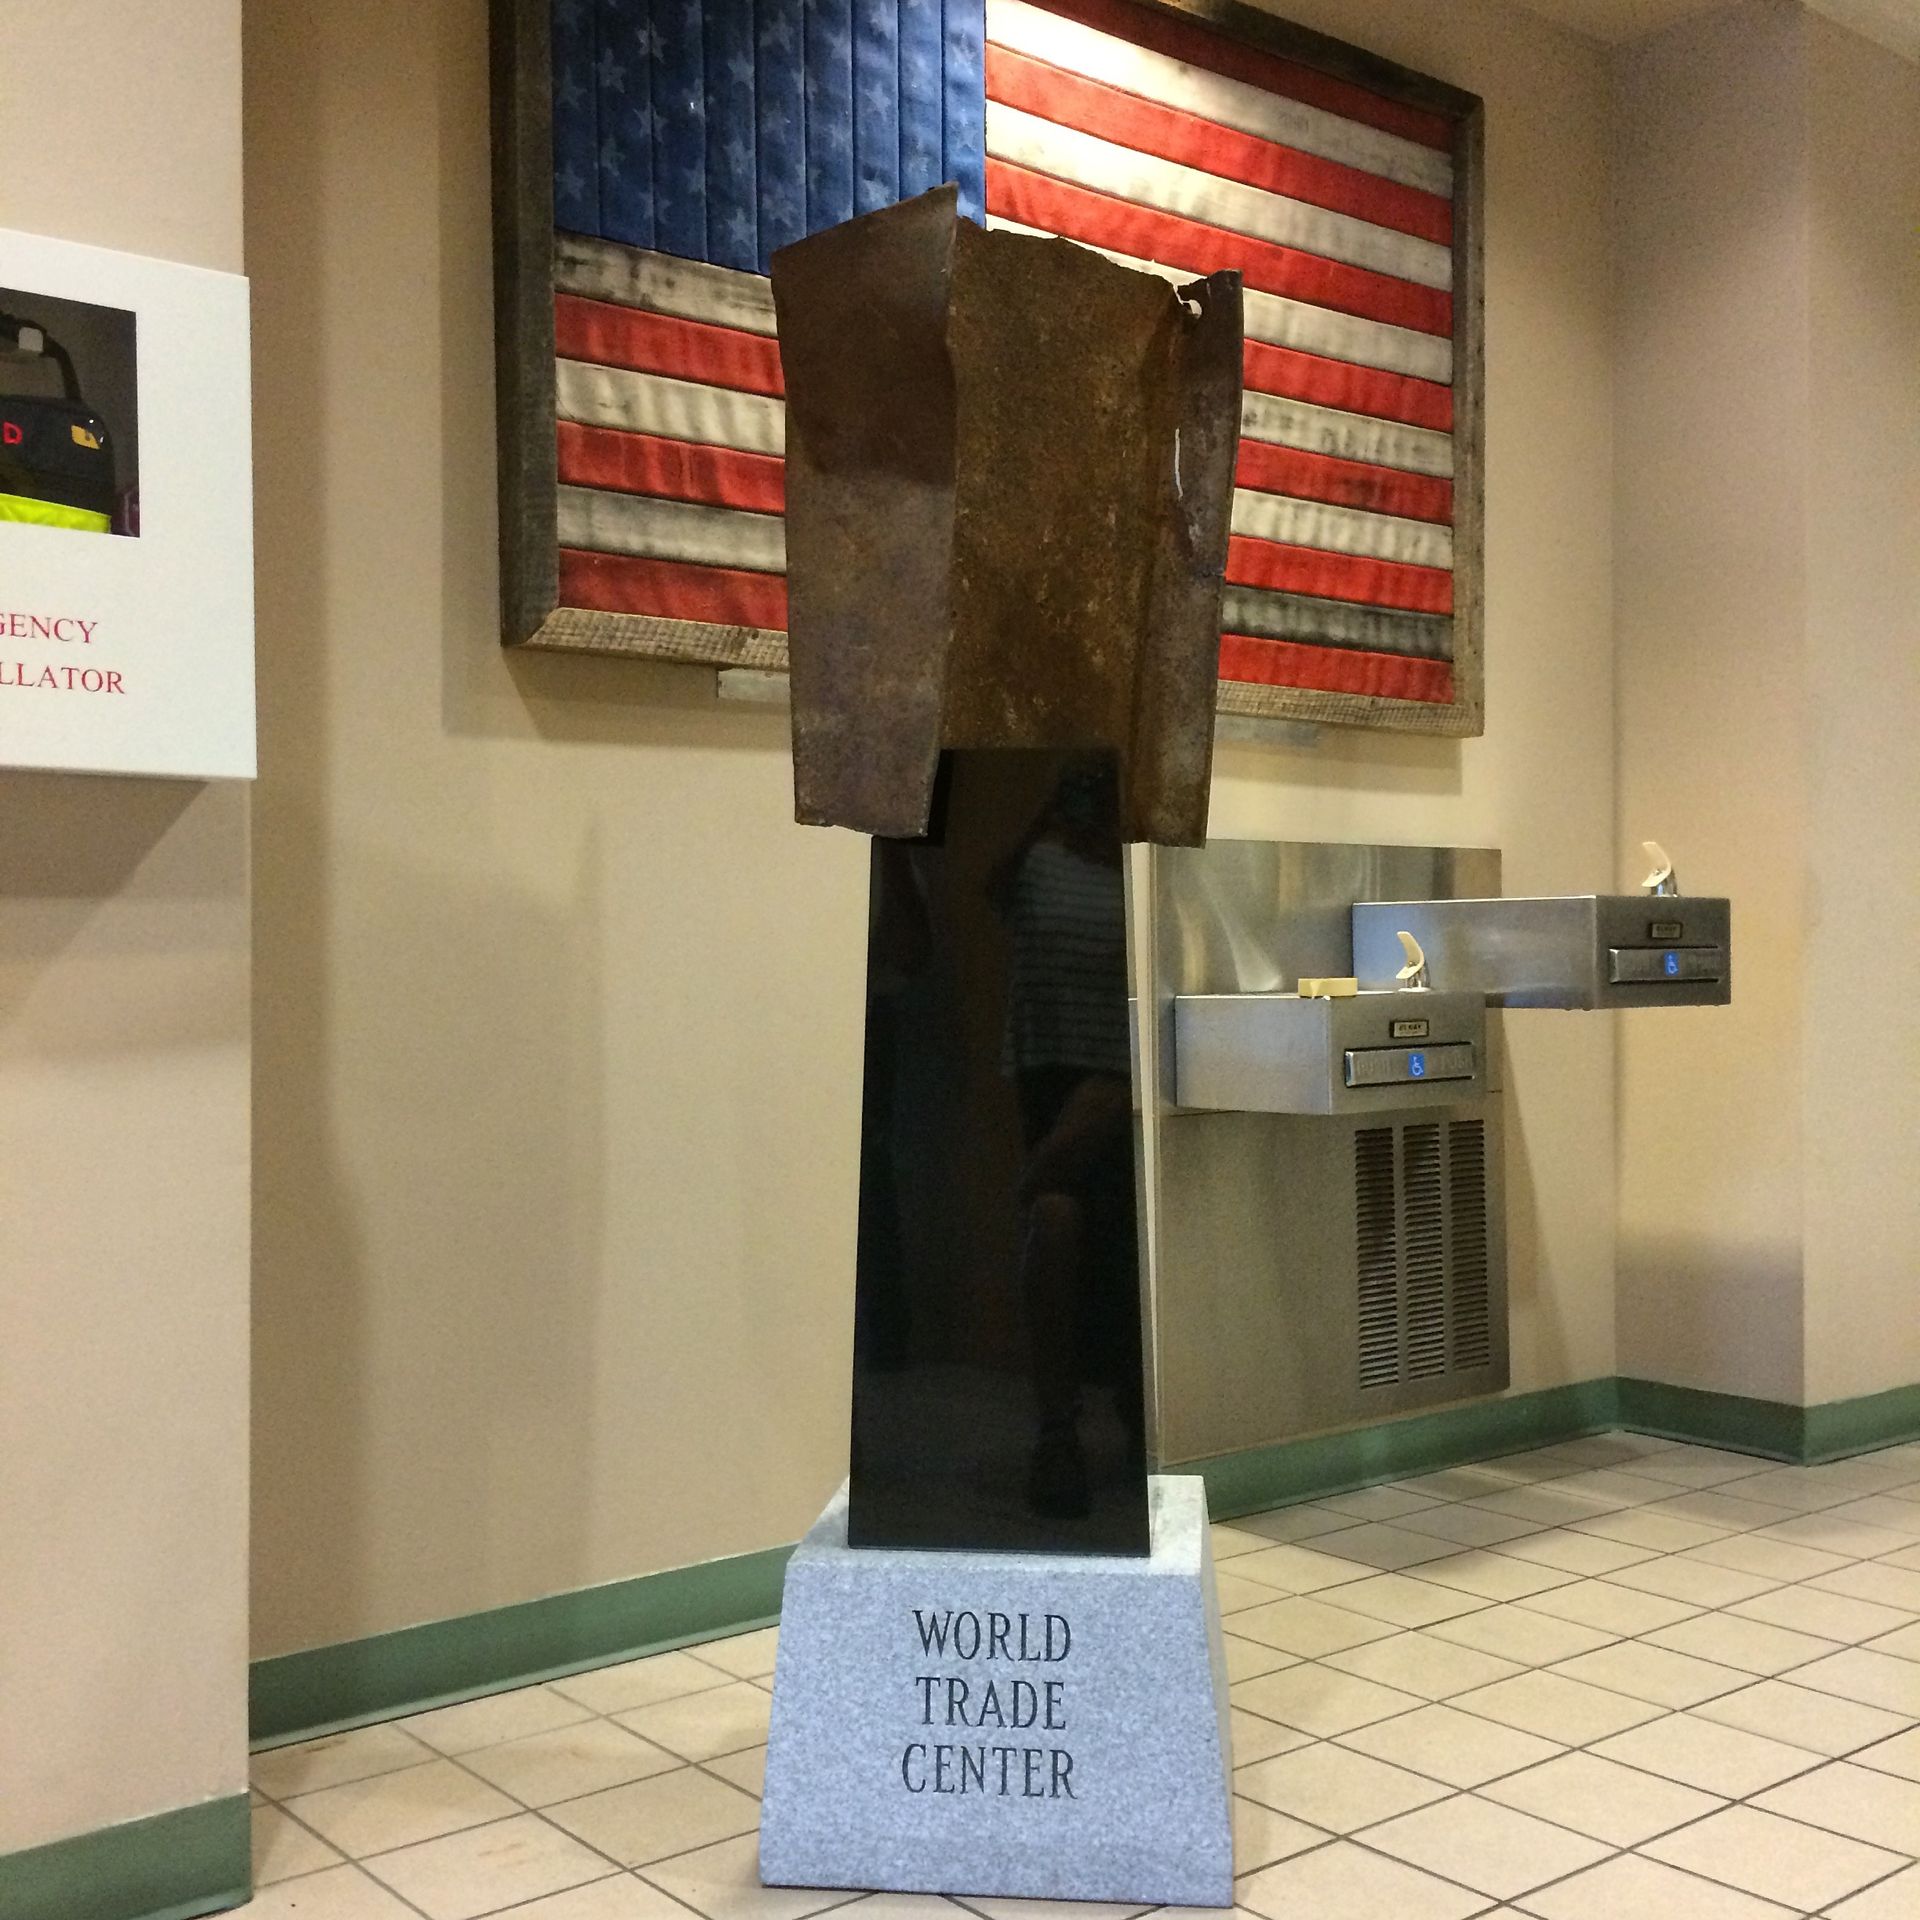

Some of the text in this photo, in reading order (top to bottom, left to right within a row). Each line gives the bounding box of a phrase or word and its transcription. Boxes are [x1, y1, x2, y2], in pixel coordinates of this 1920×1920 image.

[911, 1609, 1072, 1663] WORLD
[915, 1676, 1066, 1730] TRADE
[901, 1743, 1078, 1800] CENTER
